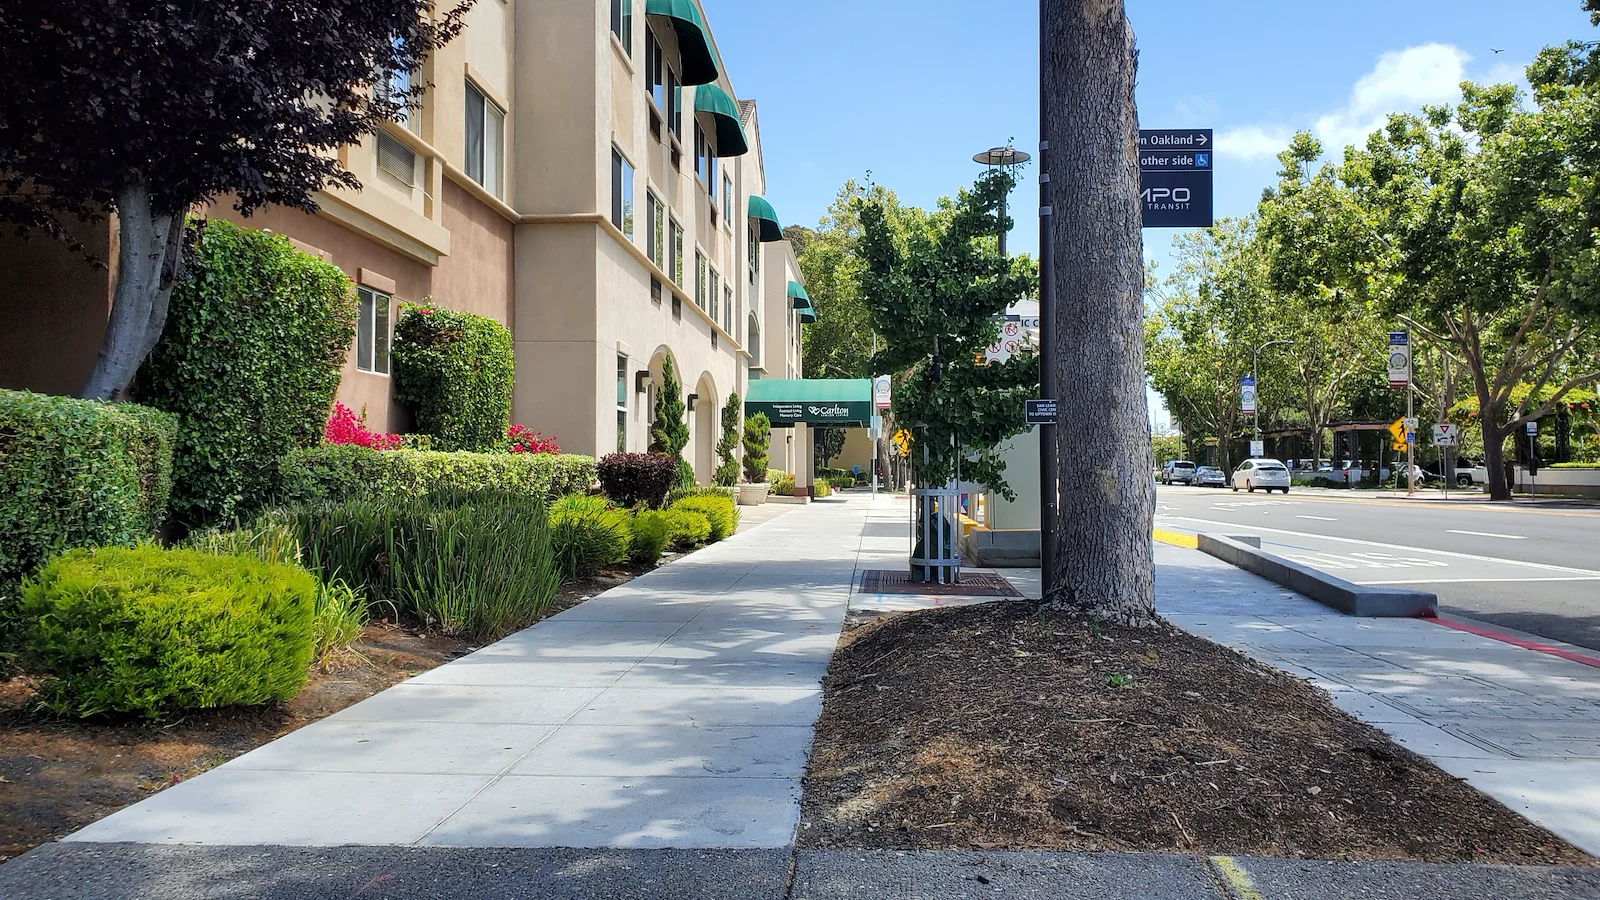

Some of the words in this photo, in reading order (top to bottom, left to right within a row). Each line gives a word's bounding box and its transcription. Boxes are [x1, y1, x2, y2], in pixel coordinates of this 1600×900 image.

[1150, 134, 1193, 145] Oakland
[1141, 155, 1169, 166] other
[1172, 155, 1193, 166] side
[821, 404, 849, 415] Carlton
